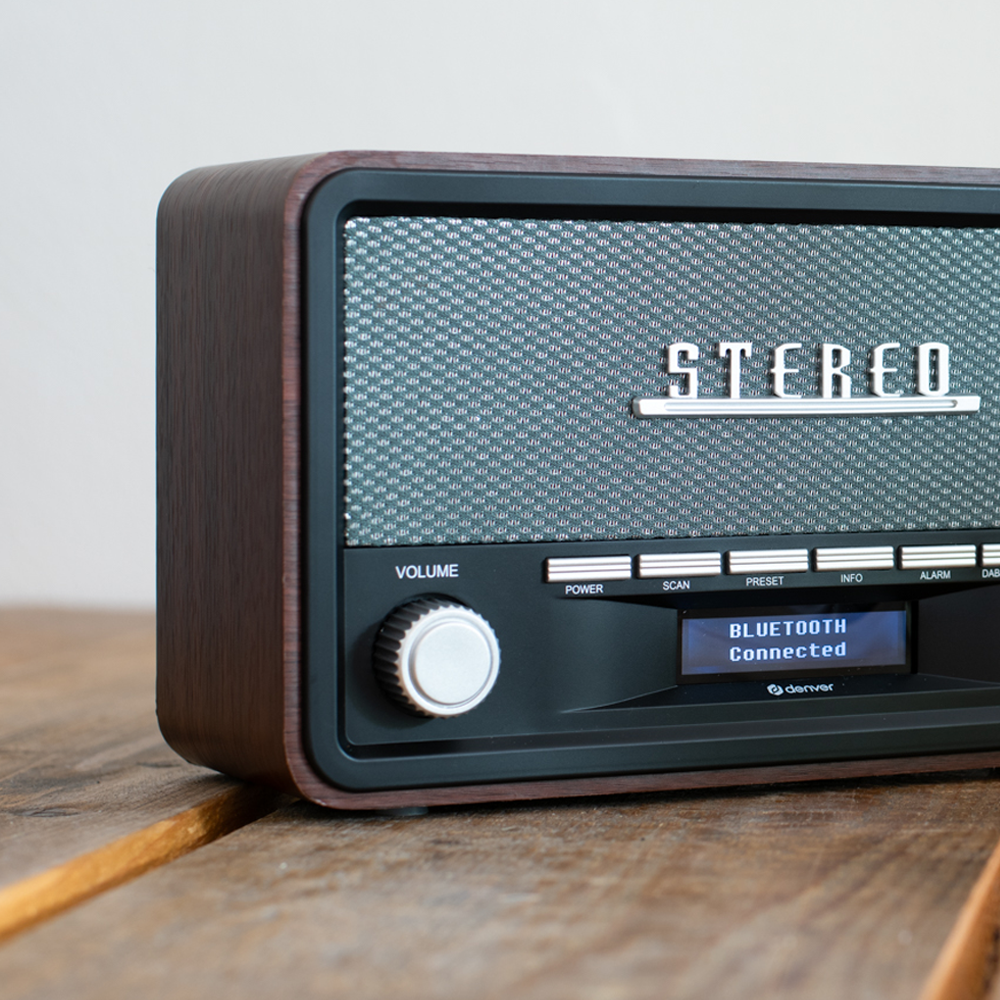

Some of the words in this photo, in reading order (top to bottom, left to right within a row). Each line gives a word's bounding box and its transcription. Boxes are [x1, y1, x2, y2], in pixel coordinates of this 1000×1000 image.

[667, 342, 950, 399] STEREO
[395, 564, 459, 580] VOLUME
[920, 570, 951, 580] ALARM
[746, 576, 784, 587] PRESET
[841, 573, 863, 583] INFO
[565, 584, 604, 595] POWER
[663, 580, 690, 591] SCAN
[729, 618, 847, 639] BLUETOOTH
[729, 640, 847, 662] Connected
[785, 682, 834, 694] denver
